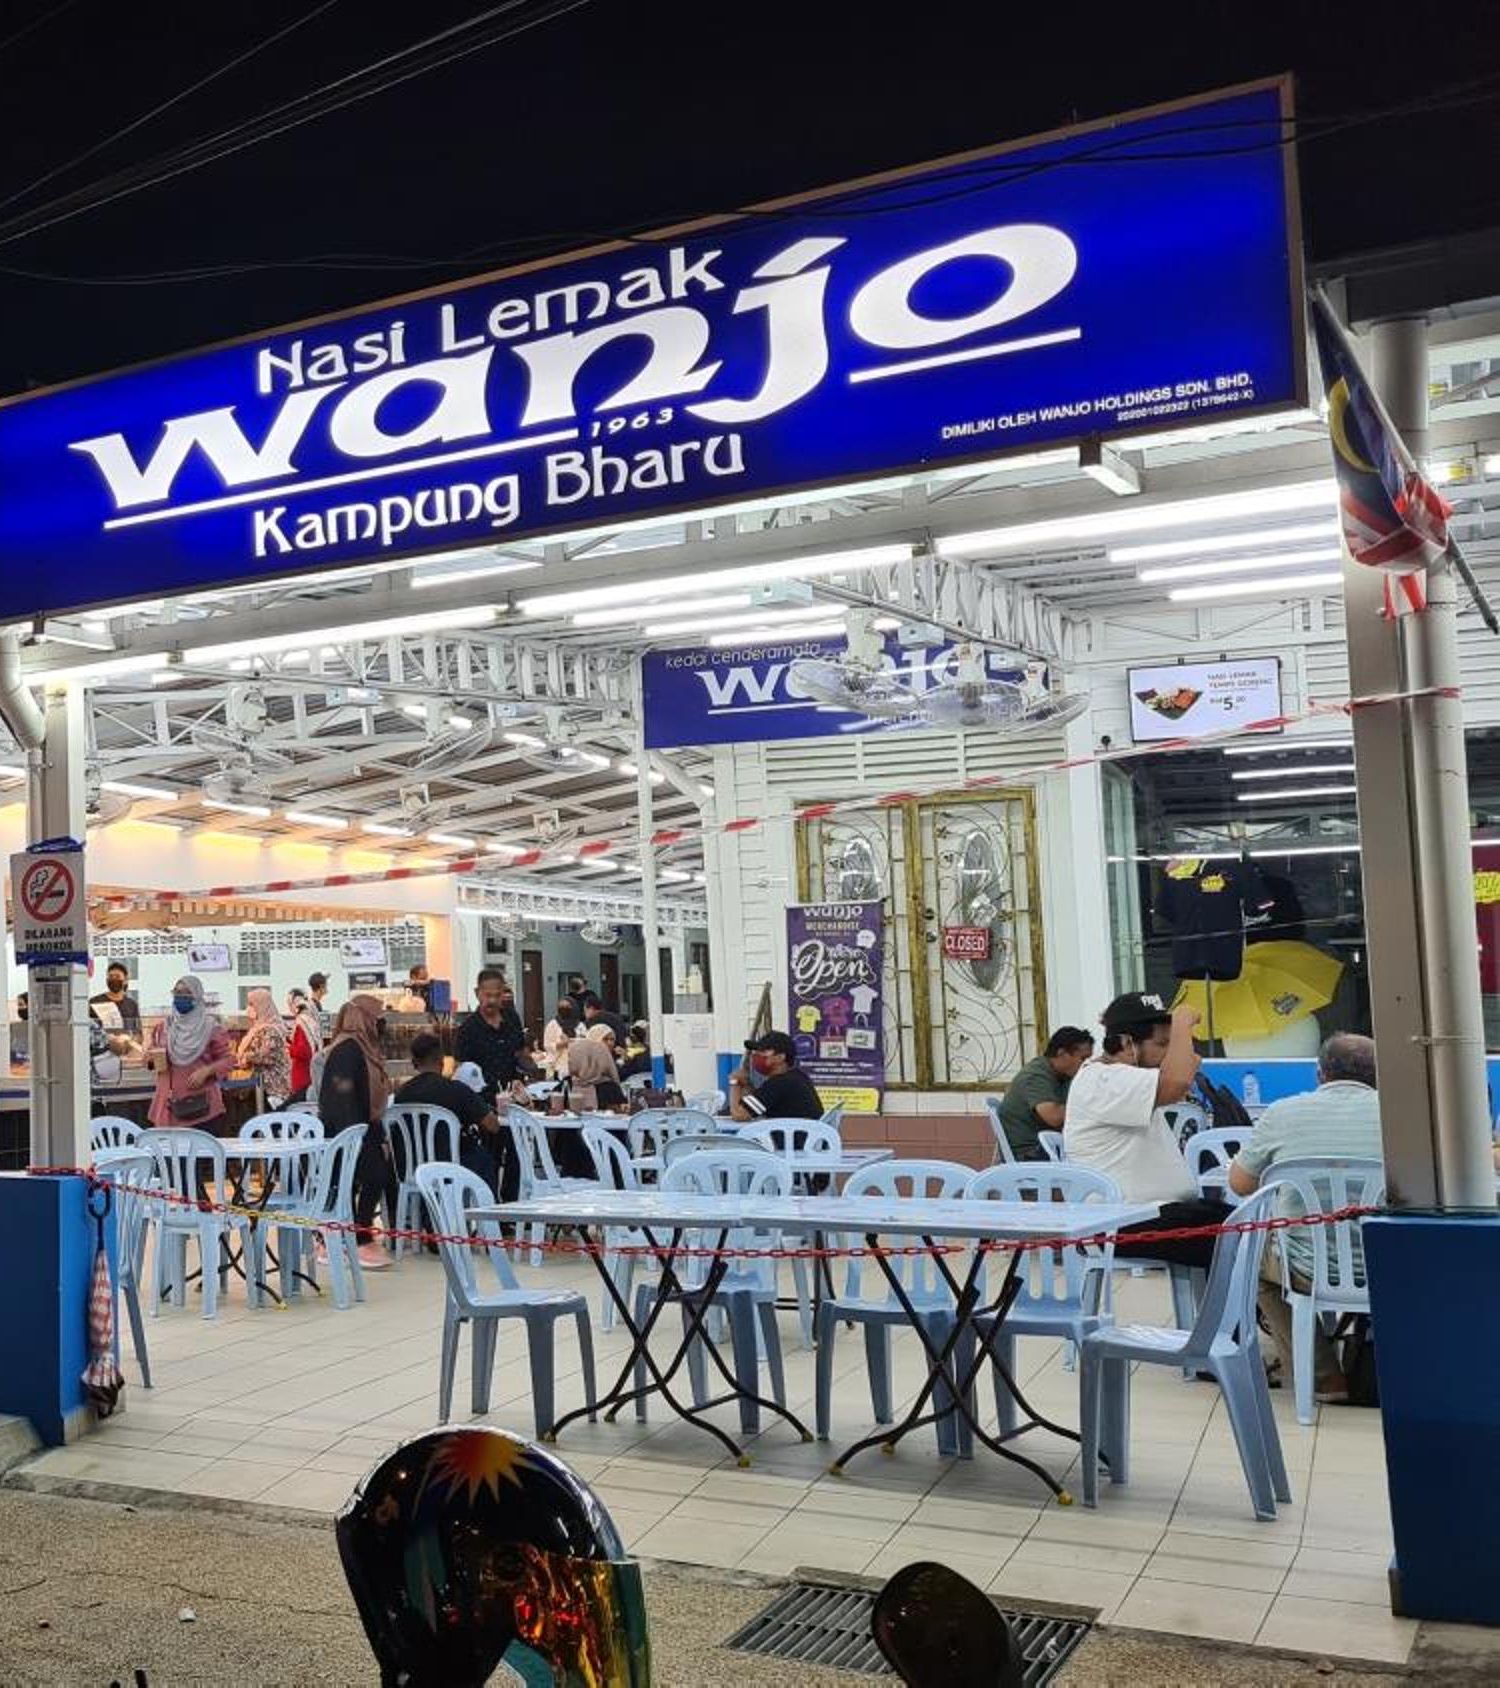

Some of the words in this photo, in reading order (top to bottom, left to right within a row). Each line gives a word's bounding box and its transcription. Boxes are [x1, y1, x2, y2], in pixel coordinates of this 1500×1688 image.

[259, 321, 407, 395] Nasi
[441, 247, 726, 353] Lemak
[68, 223, 1080, 510] wanjo
[591, 406, 675, 437] 1963
[941, 417, 996, 439] DIMILIKI
[997, 409, 1037, 429] OLEH
[1039, 401, 1092, 422] WANJO
[1094, 386, 1173, 411] HOLDINGS
[1175, 380, 1212, 397] SDN.
[1215, 372, 1253, 390] BHD.
[254, 472, 521, 558] Kampung
[546, 433, 746, 506] Bharu
[665, 652, 707, 669] kedai
[711, 641, 821, 666] cenderamata
[24, 926, 75, 940] DILARANG
[803, 904, 864, 921] wanjo
[944, 934, 986, 951] CLOSED
[791, 938, 870, 996] Open
